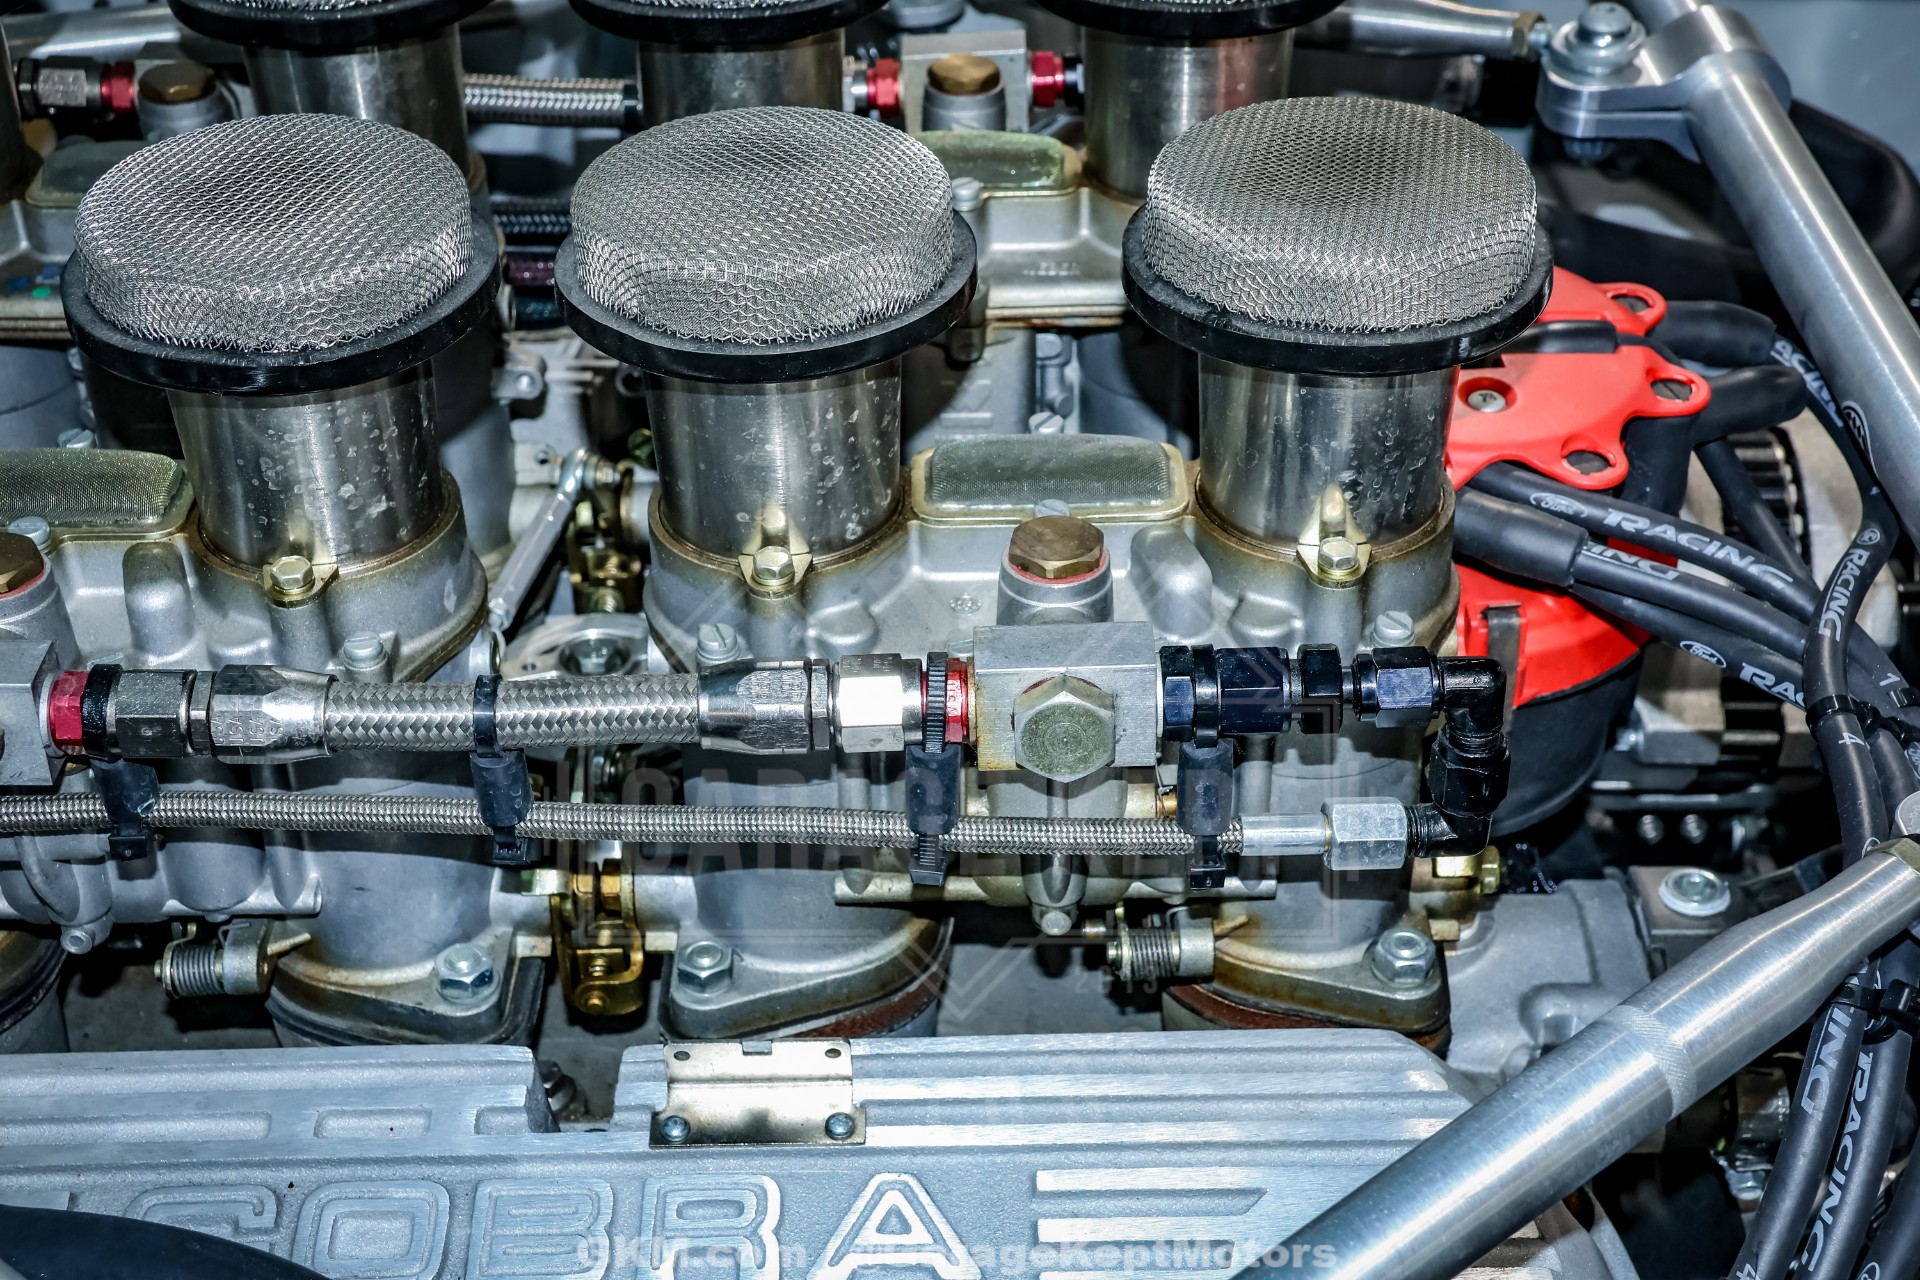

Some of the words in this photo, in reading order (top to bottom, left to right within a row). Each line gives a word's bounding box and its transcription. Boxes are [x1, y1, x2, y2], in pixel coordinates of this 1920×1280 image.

[1585, 540, 1680, 581] ING
[1603, 508, 1794, 589] RACING
[1818, 548, 1871, 642] RACING
[1838, 732, 1865, 745] 4
[1800, 1005, 1853, 1115] ING
[1801, 1051, 1874, 1272] RACING
